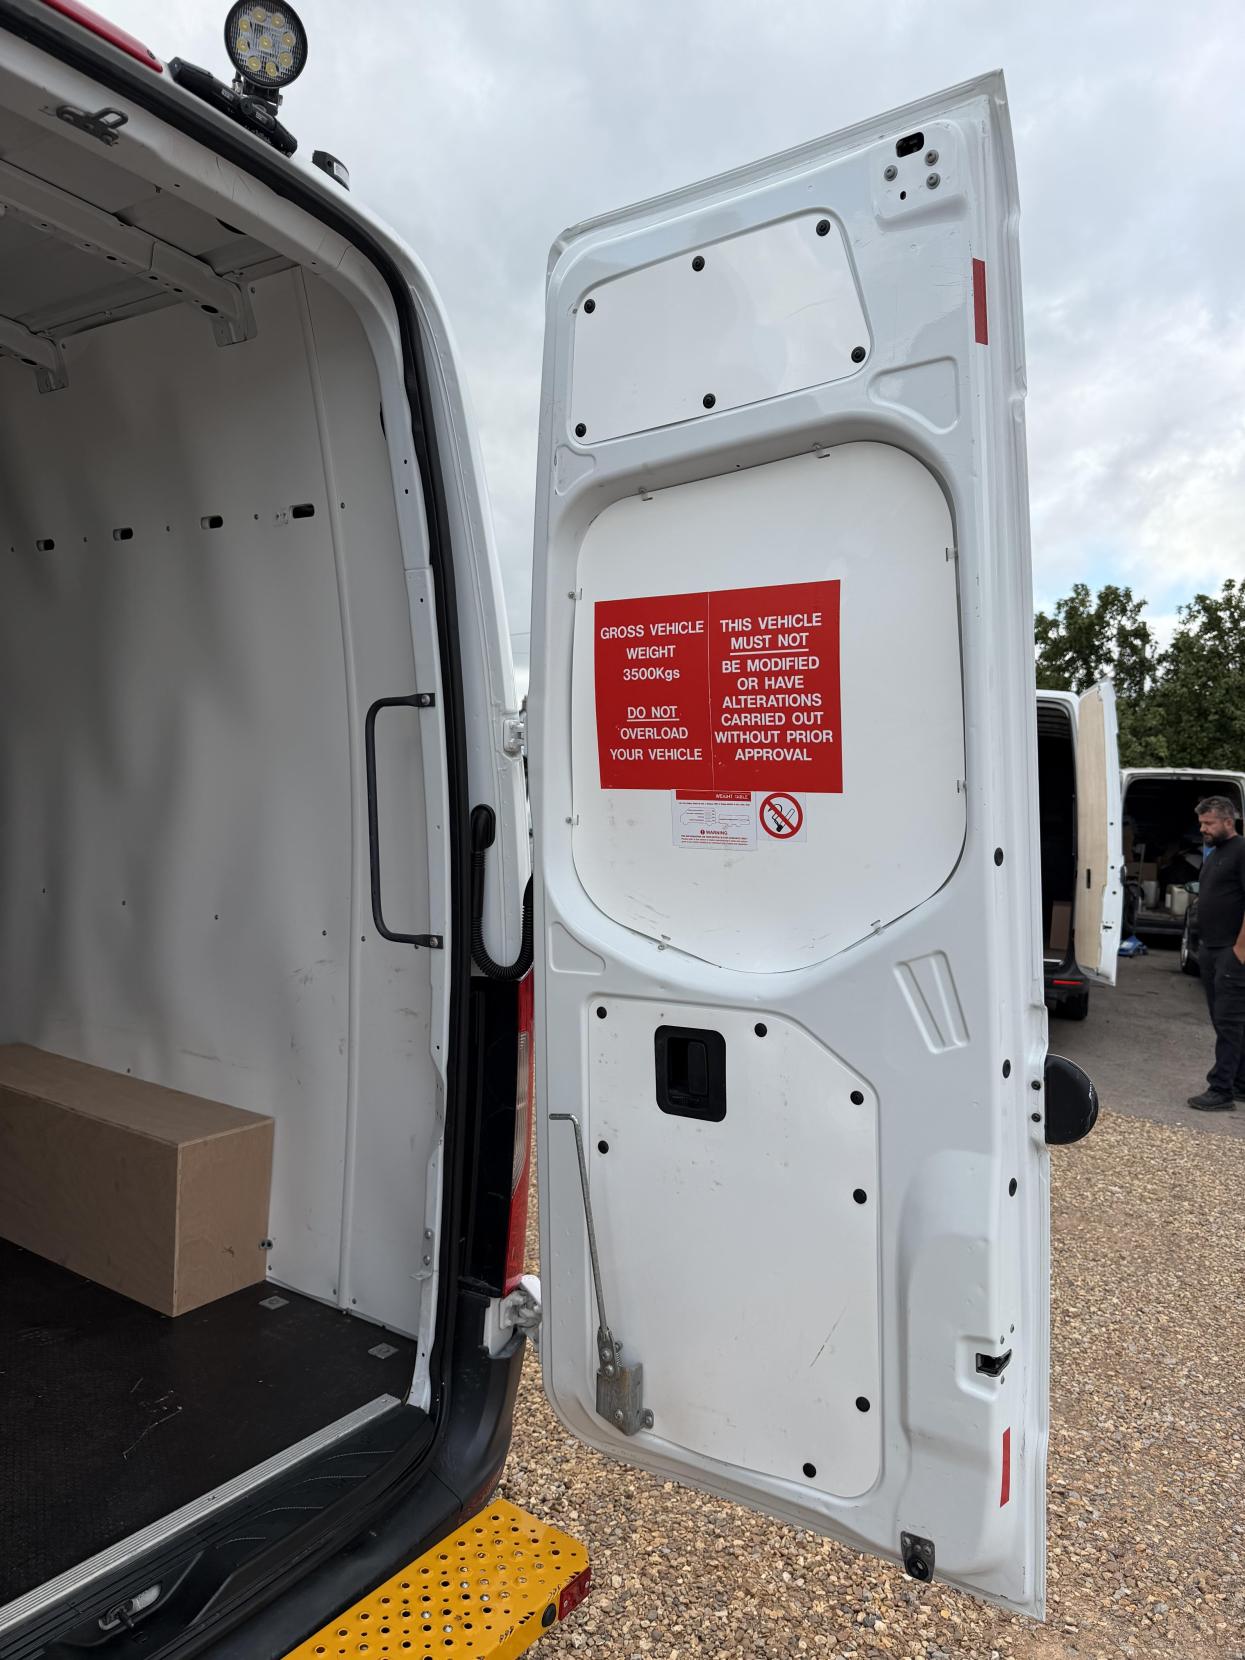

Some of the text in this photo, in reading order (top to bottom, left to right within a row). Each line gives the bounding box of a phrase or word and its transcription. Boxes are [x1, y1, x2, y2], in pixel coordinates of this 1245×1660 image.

[600, 619, 705, 640] GROSS VEHICLE
[720, 612, 822, 633] THIS VEHICLE
[730, 632, 810, 650] MUST NOT
[626, 645, 677, 660] WEIGHT
[722, 656, 820, 674] BE MODIFIED
[623, 667, 681, 682] 3500Kgs
[737, 676, 805, 691] OR HAVE
[722, 693, 822, 709] ALTERATIONS
[627, 705, 678, 719] DO NOT
[721, 711, 824, 727] CARRIED OUT
[620, 726, 689, 740] OVERLOAD
[714, 729, 833, 744] WITHOUT PRIOR
[610, 748, 703, 761] YOUR VEHICLE
[734, 748, 813, 762] APPROVAL
